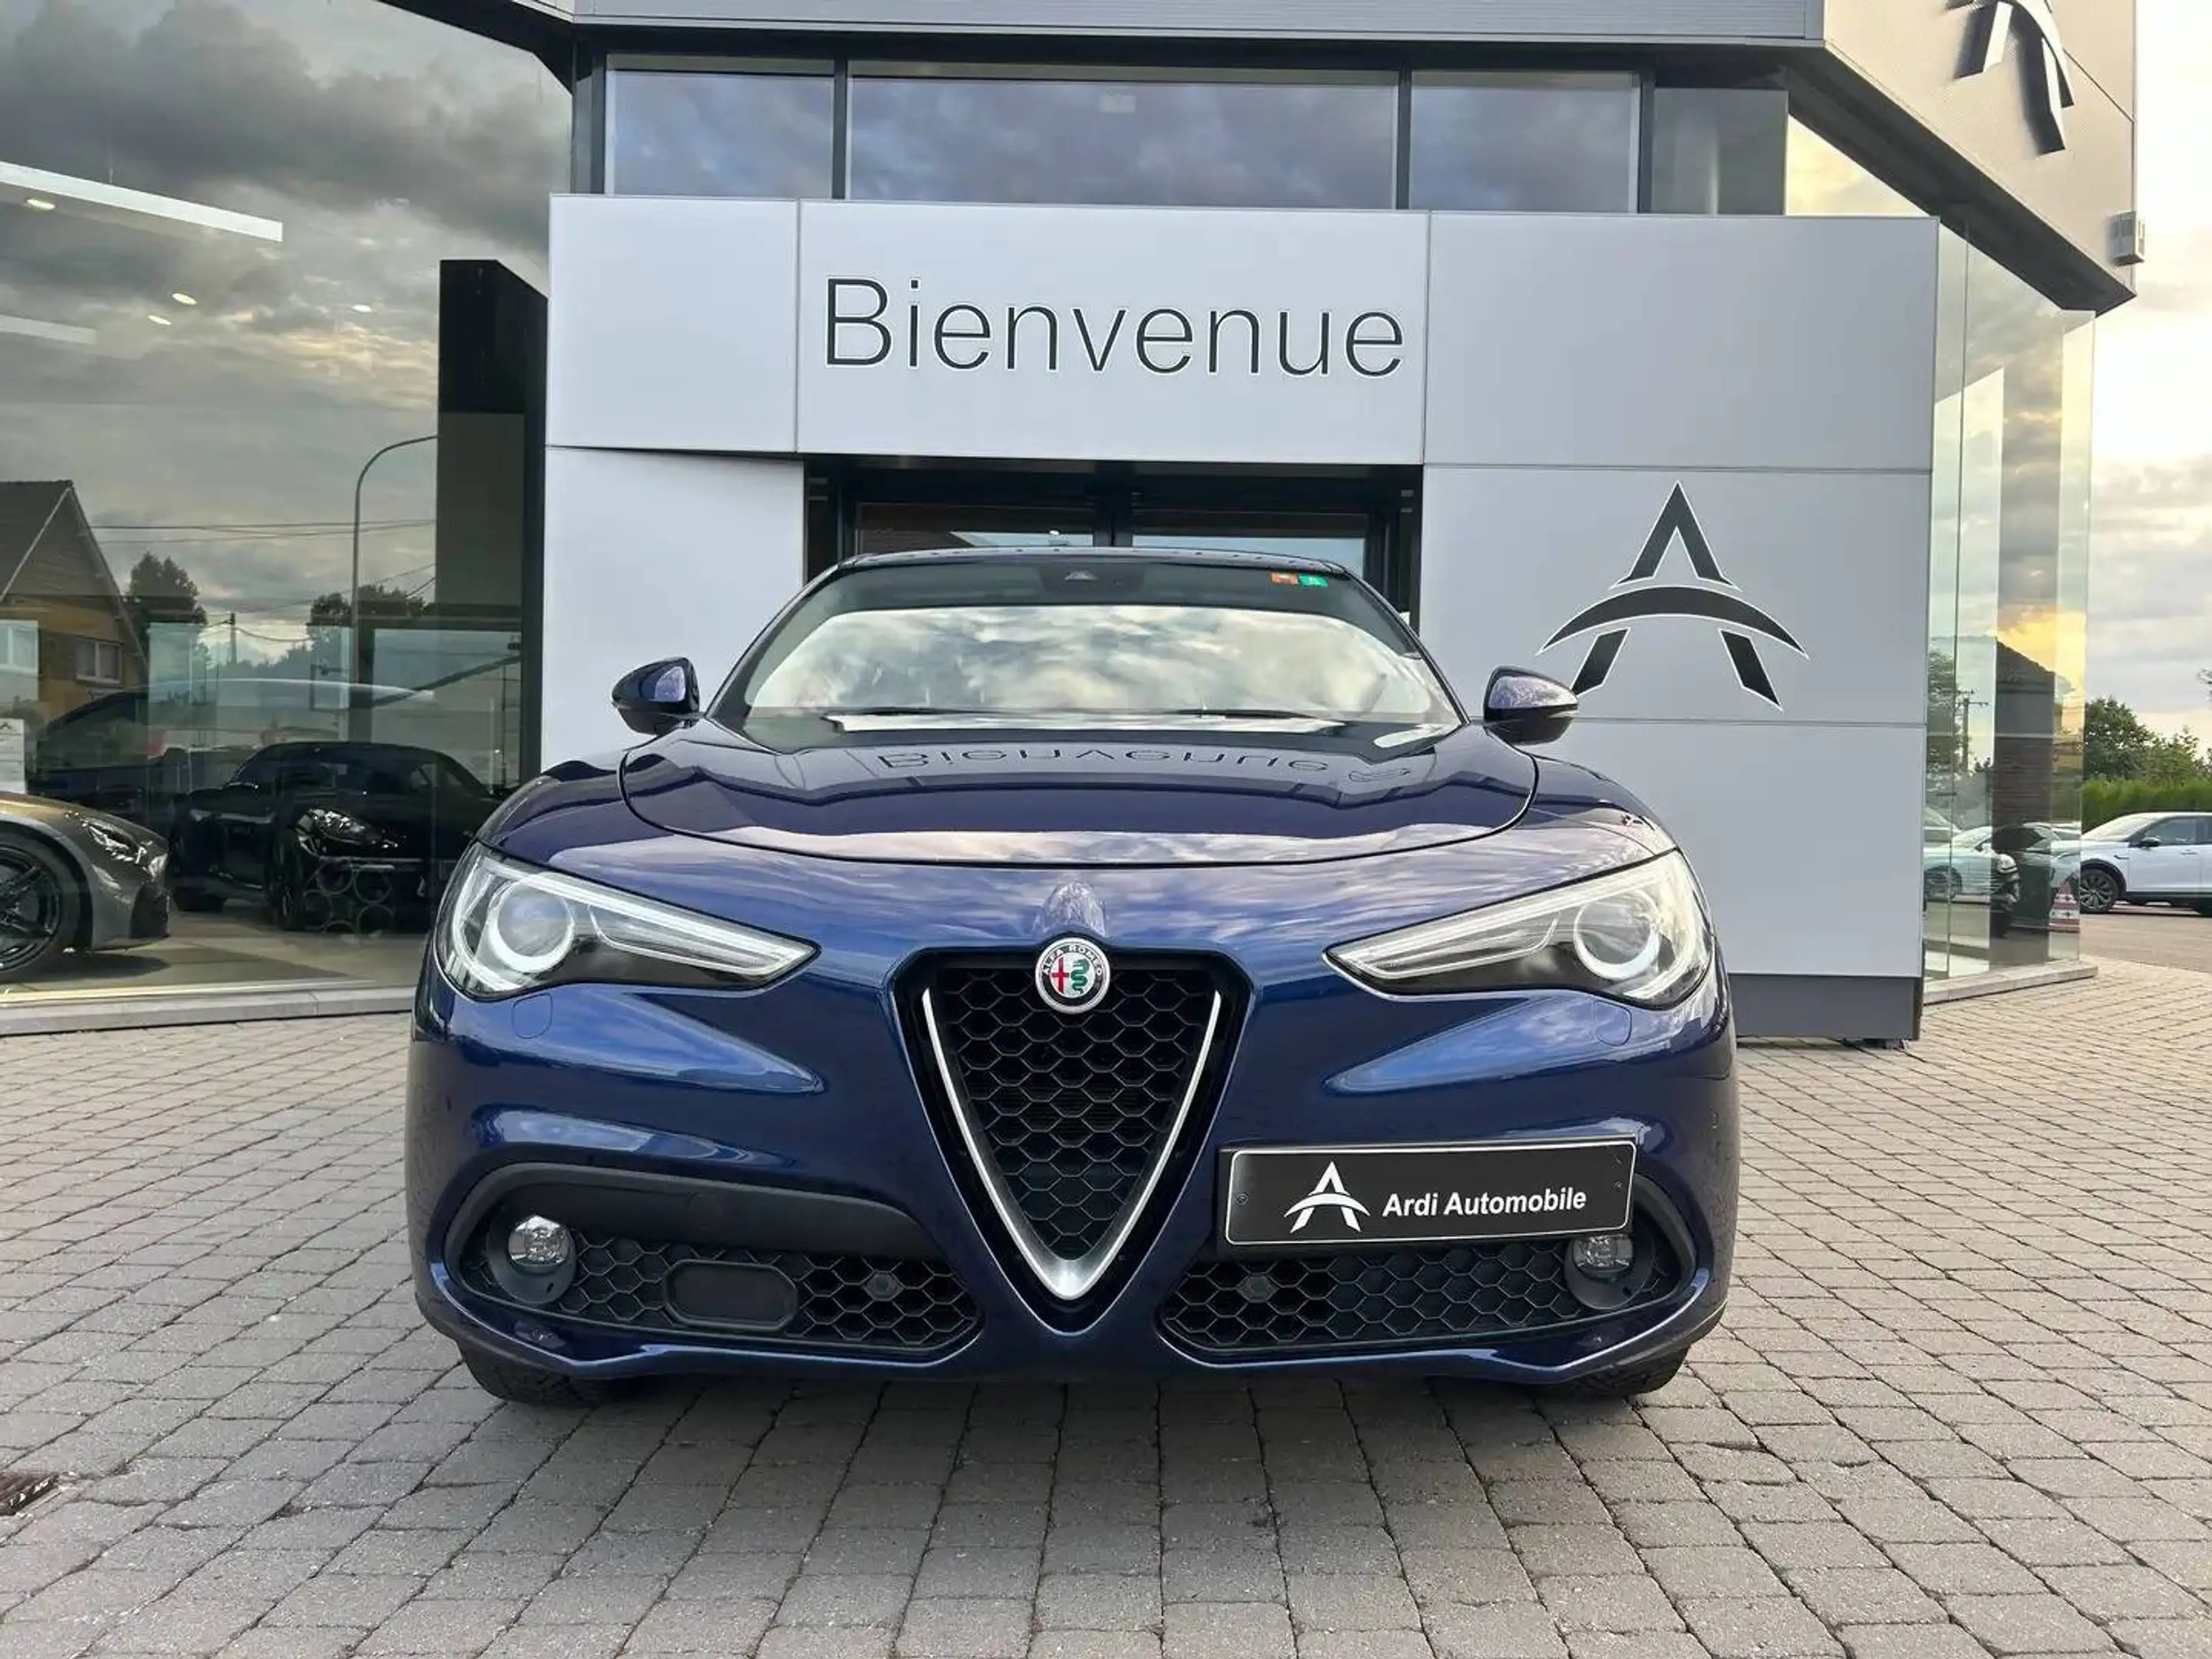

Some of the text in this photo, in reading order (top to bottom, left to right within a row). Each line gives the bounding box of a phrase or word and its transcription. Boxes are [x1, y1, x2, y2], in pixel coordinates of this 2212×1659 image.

[825, 278, 1403, 377] Bienvenue
[1382, 1187, 1587, 1217] Ardi Automobile
